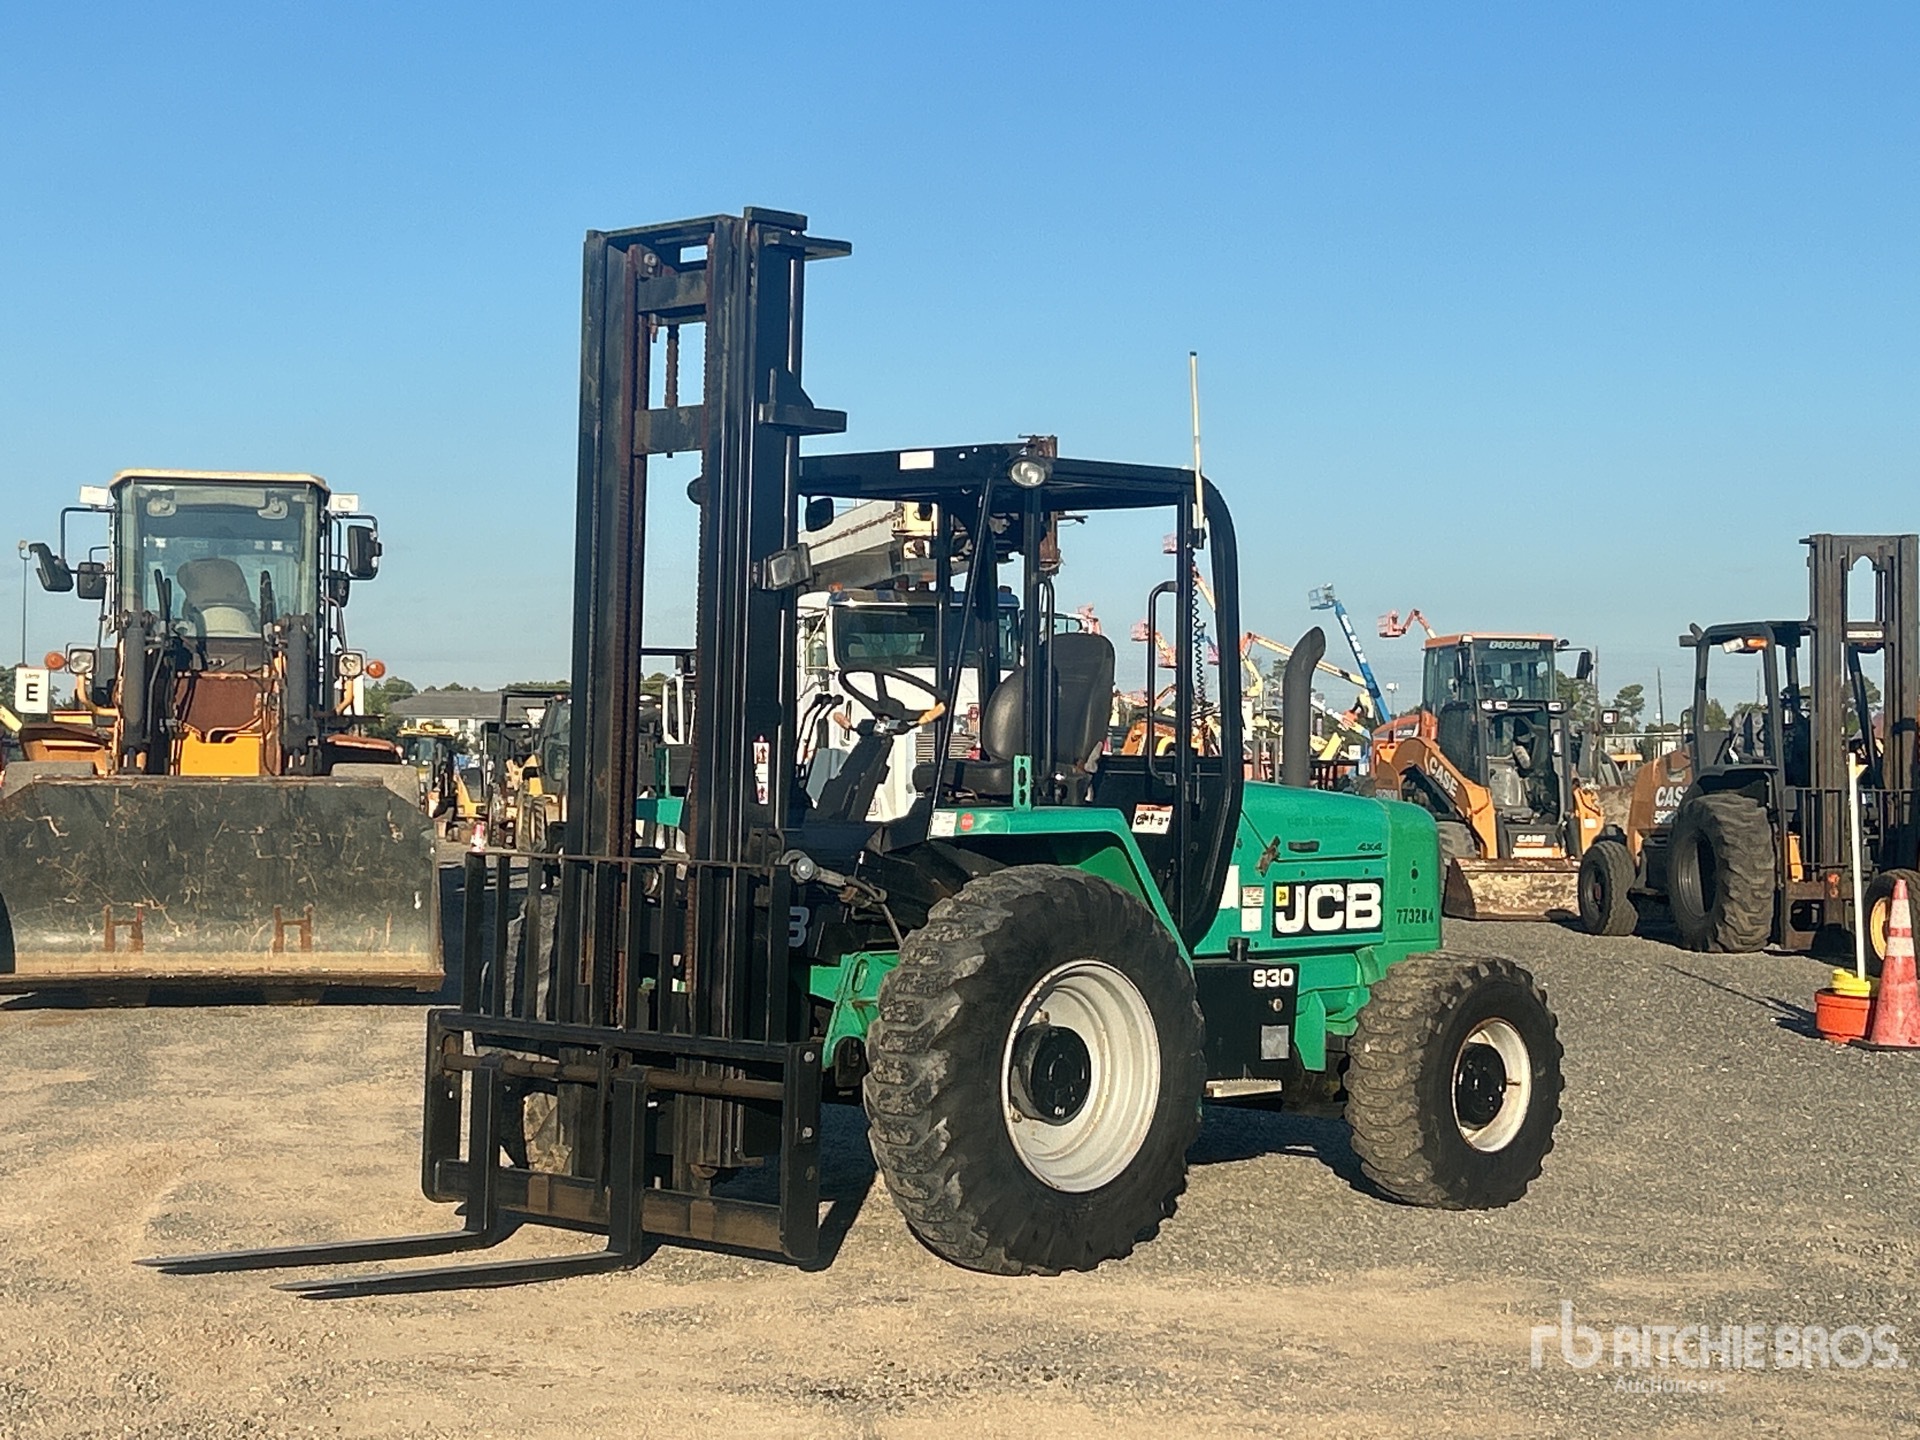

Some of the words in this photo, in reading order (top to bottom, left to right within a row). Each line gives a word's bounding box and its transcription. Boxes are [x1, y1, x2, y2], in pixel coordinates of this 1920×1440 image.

[26, 682, 38, 702] E
[1429, 757, 1458, 797] CASE
[1655, 786, 1689, 808] CAS
[1275, 883, 1382, 933] JCB
[1253, 968, 1294, 987] 930
